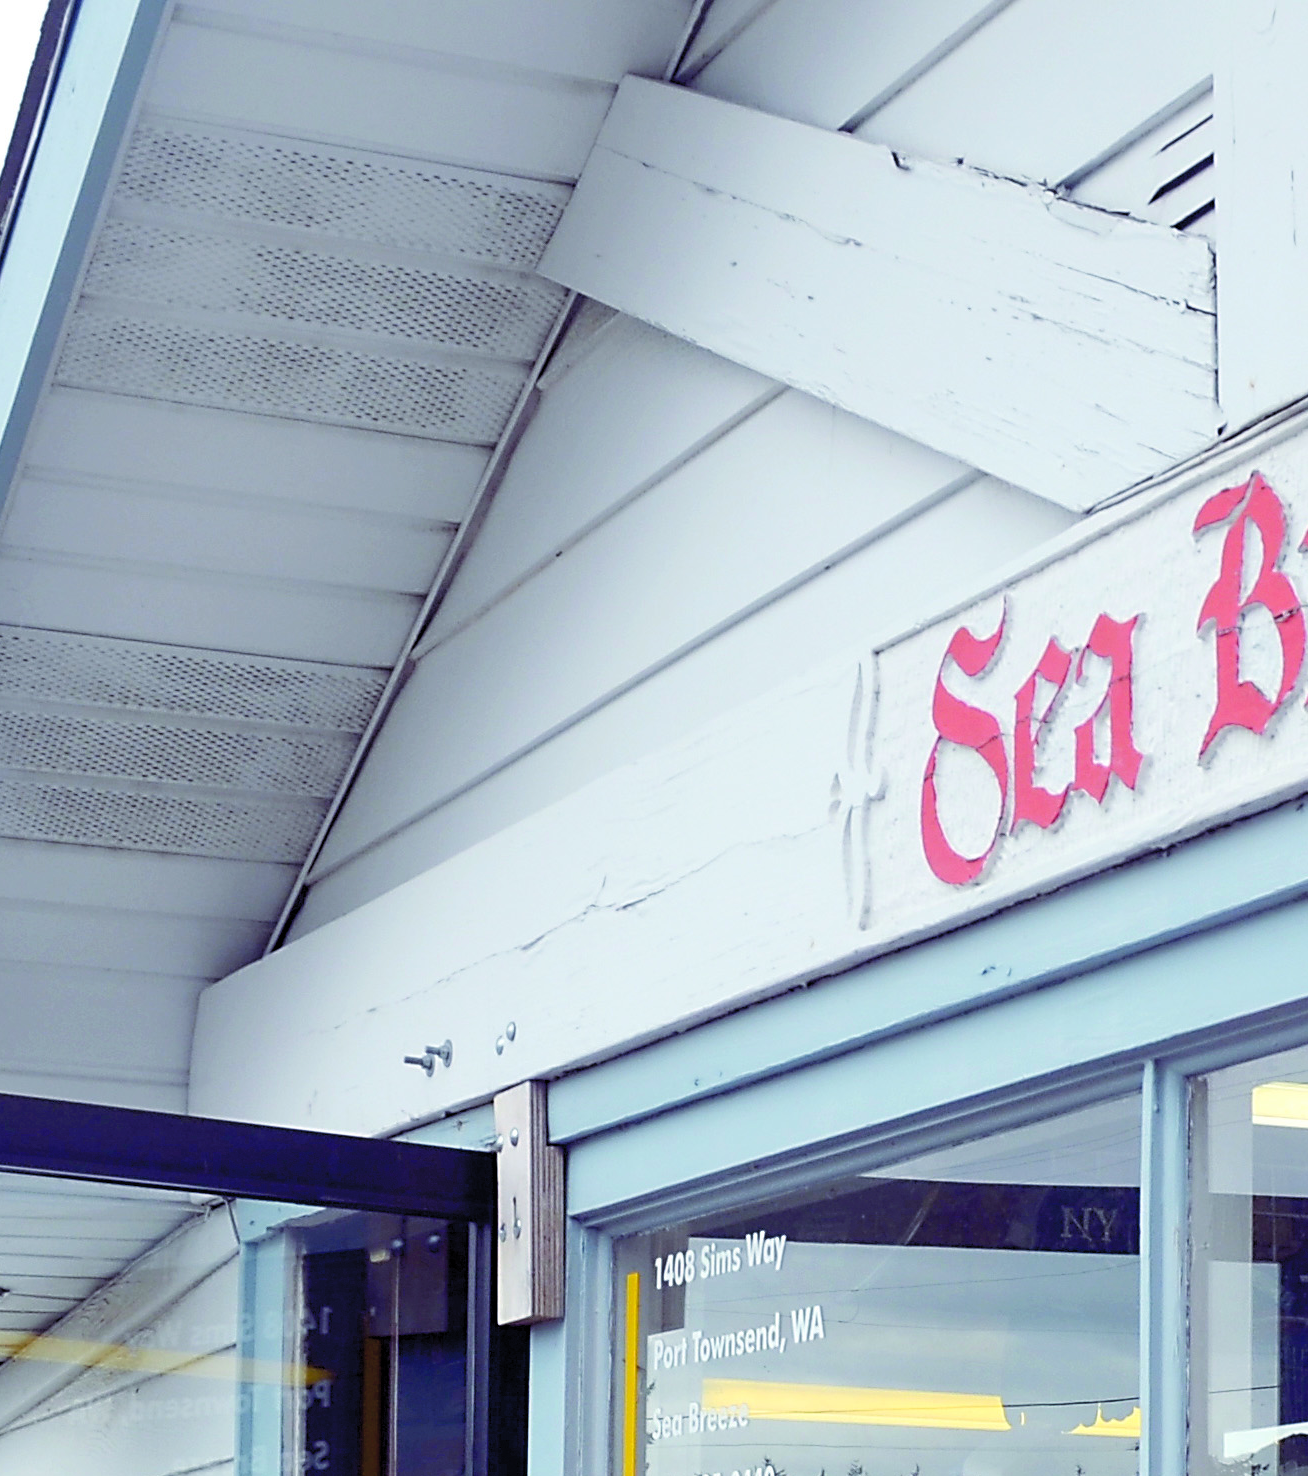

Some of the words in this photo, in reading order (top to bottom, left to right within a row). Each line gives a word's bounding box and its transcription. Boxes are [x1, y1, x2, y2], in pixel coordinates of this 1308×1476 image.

[920, 595, 1144, 887] Sea
[655, 1250, 695, 1289] 1408
[700, 1243, 741, 1279] Sims
[745, 1230, 786, 1270] Way
[653, 1337, 687, 1370] Port
[693, 1312, 786, 1363] Townsend,
[791, 1305, 824, 1343] WA
[652, 1408, 682, 1439] Sea
[689, 1402, 749, 1433] Breeze
